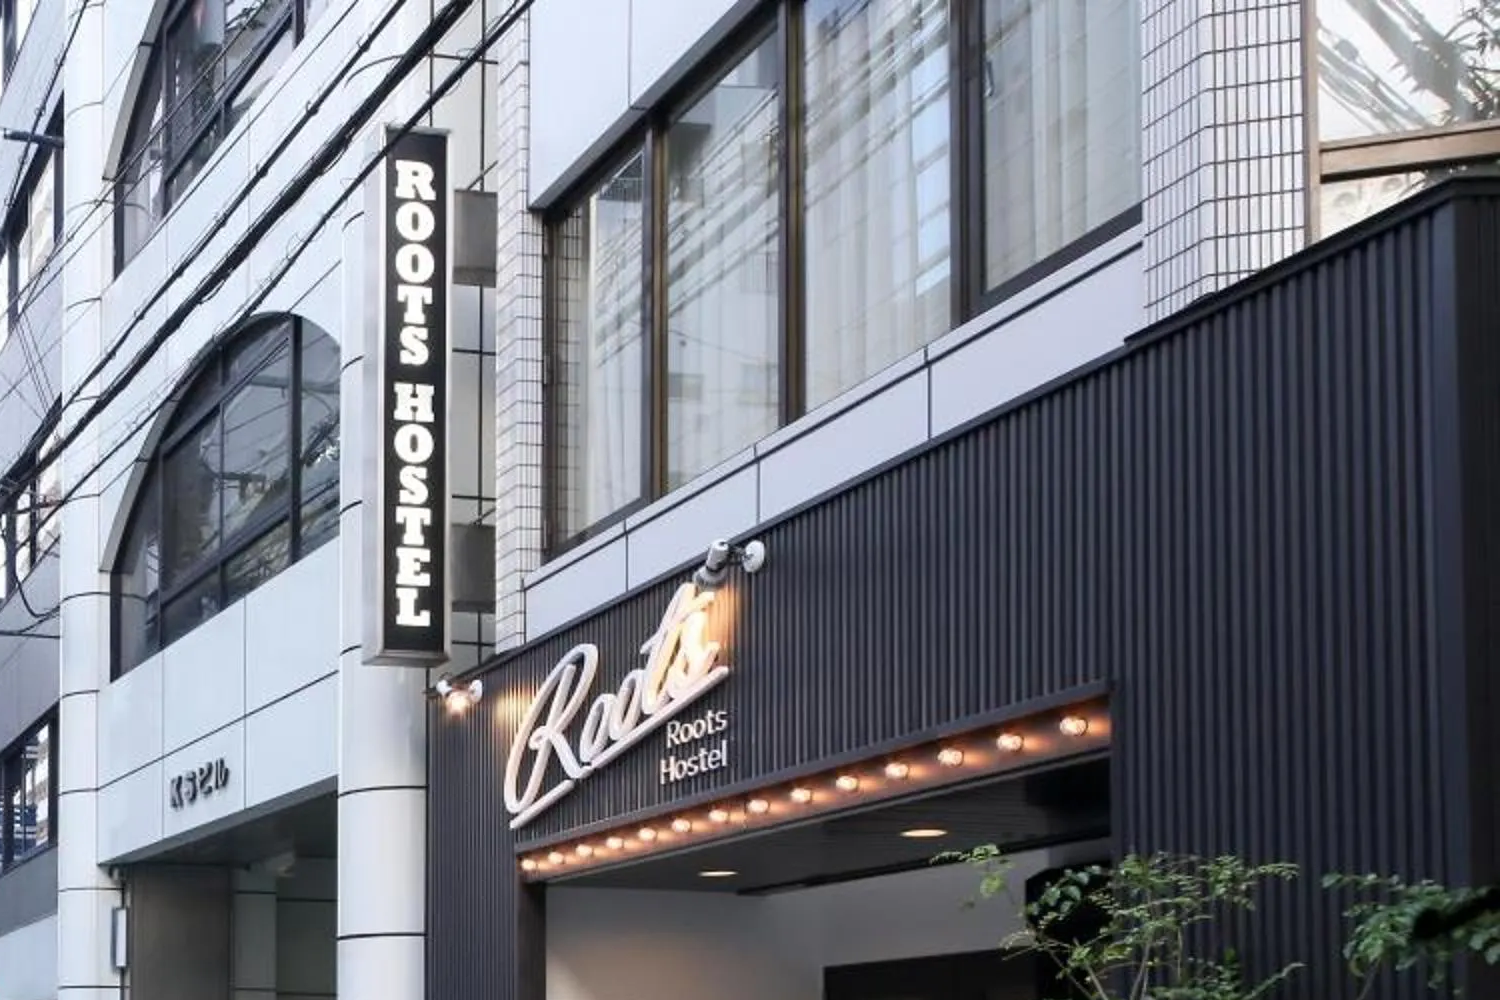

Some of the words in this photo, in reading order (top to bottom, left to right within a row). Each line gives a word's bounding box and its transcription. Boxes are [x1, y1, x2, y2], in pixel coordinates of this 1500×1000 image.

[394, 160, 436, 366] ROOTS
[394, 383, 435, 628] HOSTEL
[504, 582, 722, 816] Roots
[660, 740, 729, 785] Hostel
[666, 710, 729, 749] Roots
